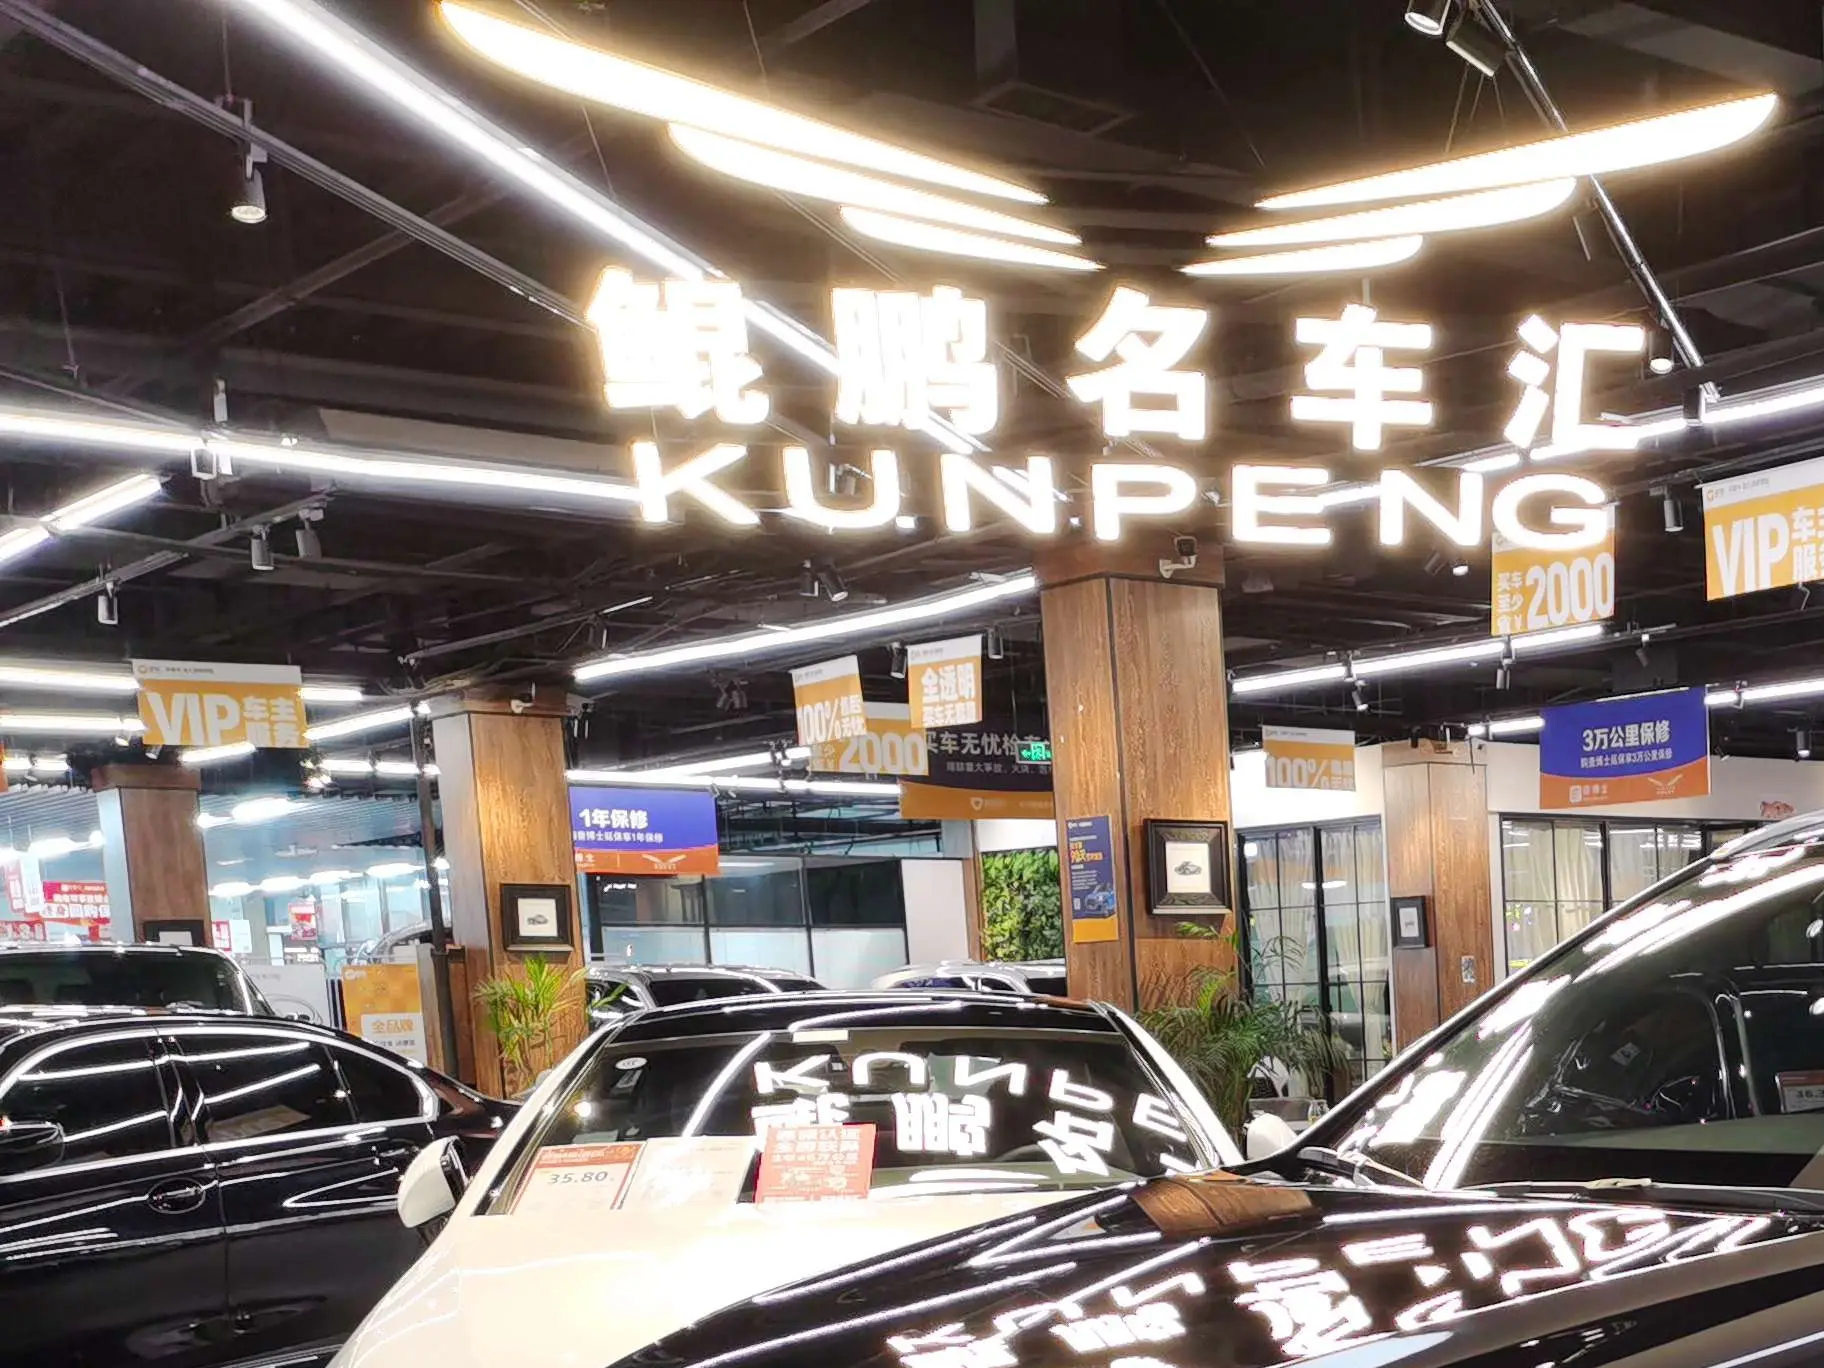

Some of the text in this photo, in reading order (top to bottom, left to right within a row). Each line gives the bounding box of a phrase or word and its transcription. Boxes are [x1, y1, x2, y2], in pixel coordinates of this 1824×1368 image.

[632, 440, 1610, 551] KUNPENG
[1712, 513, 1790, 597] VIP
[1525, 551, 1615, 632] 2000
[146, 691, 241, 746] VIP
[1582, 719, 1671, 752] 3万公里保修
[578, 808, 649, 830] 1年保修
